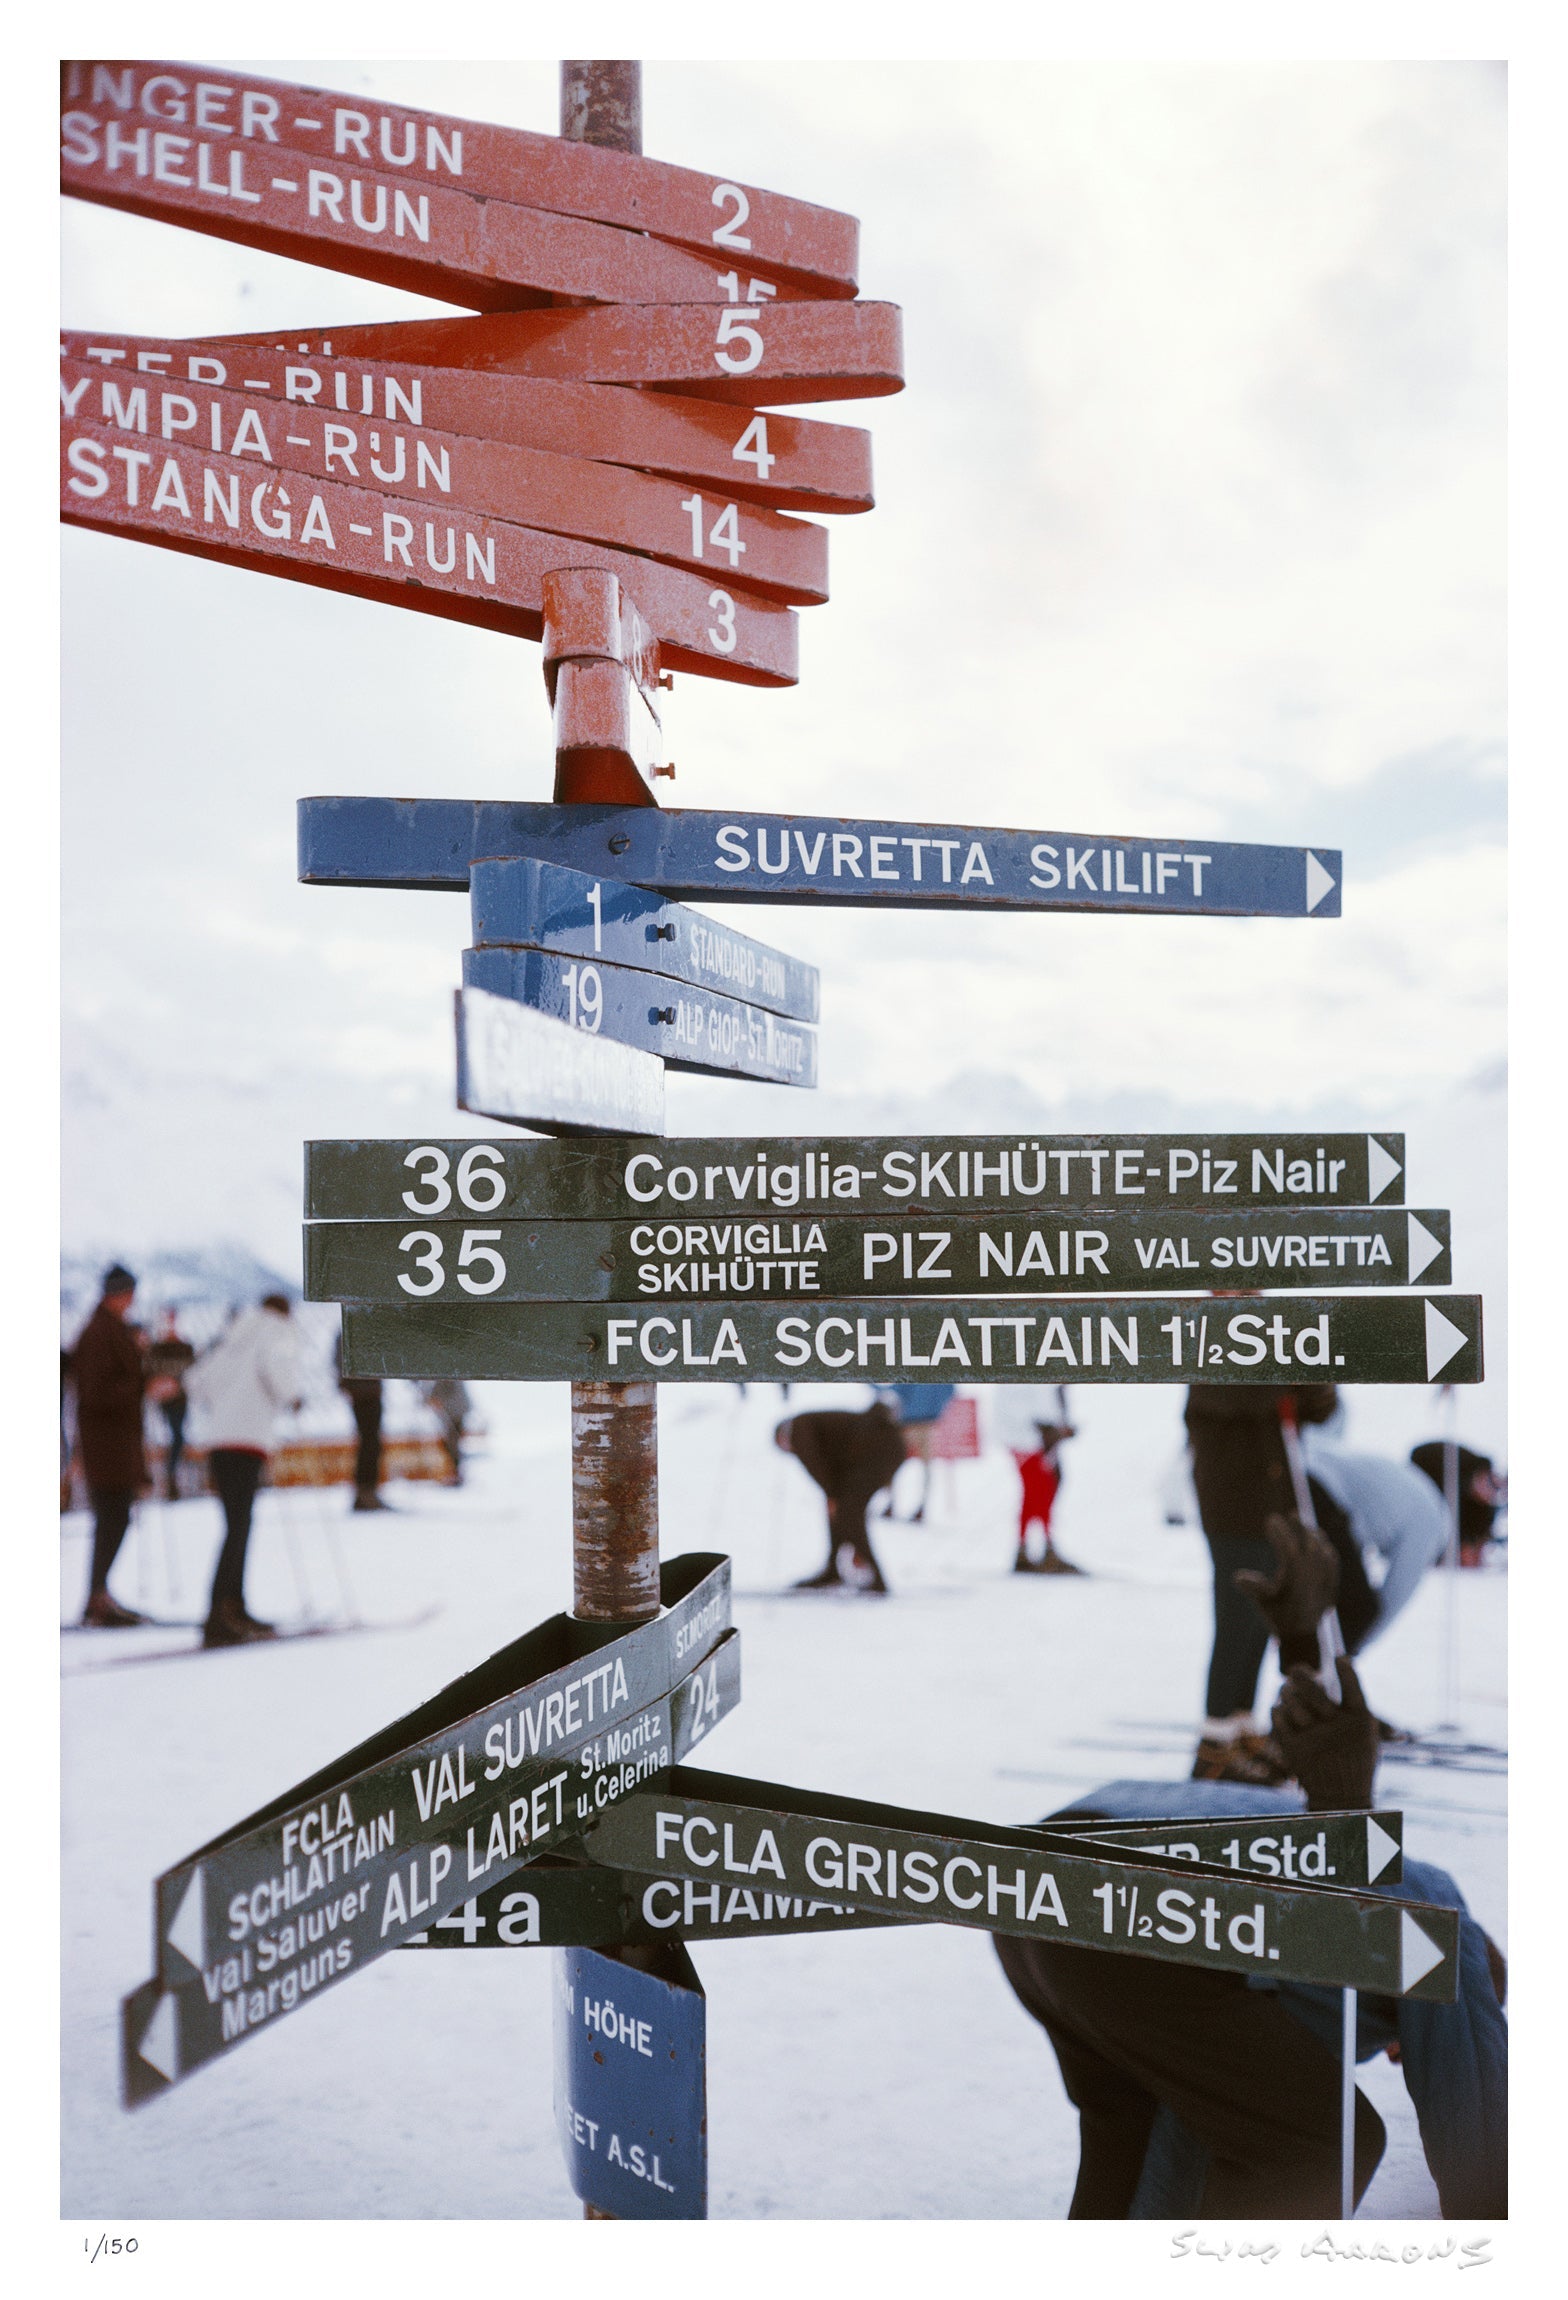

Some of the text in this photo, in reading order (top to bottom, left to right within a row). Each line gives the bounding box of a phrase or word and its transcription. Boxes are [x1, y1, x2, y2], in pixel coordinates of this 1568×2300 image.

[61, 111, 430, 242] SHELL-RUN
[711, 184, 752, 250] 2
[714, 308, 764, 374] 5
[732, 416, 775, 479] 4
[67, 437, 737, 653] STANGA-RUN 3
[681, 494, 746, 567] 14
[714, 825, 1212, 897] SUVRETTA SKILIFT
[587, 883, 786, 999] 1 STANDARD-RUN
[562, 965, 602, 1034] 19
[675, 999, 704, 1046] ALP
[402, 1143, 1346, 1215] 36 Corviglia-SKIHÜTTE-Piz Nair
[396, 1230, 1393, 1297] 35 PIZ NAIR VAL SUVRETTA
[630, 1224, 828, 1257] CORVIGLIA
[637, 1257, 821, 1293] SKIHÜTTE
[607, 1317, 748, 1367] FCLA
[774, 1316, 1138, 1368] SCHLATTAIN
[690, 1661, 720, 1742] 24
[412, 1657, 629, 1823] VAL SUVRETTA
[282, 1792, 354, 1866] FCLA
[380, 1771, 568, 1938] ALP LARET
[228, 1810, 395, 1942] SCHLATTAIN
[656, 1811, 786, 1880] FCLA
[804, 1837, 1069, 1928] GRISCHA
[256, 1882, 370, 1973] Saluver
[403, 1880, 856, 1945] 4a CHAM
[221, 1937, 352, 2043] Marguns
[584, 1997, 653, 2057] HÖHE
[607, 2134, 675, 2193] A.S.L.
[84, 2233, 139, 2263] 1/150
